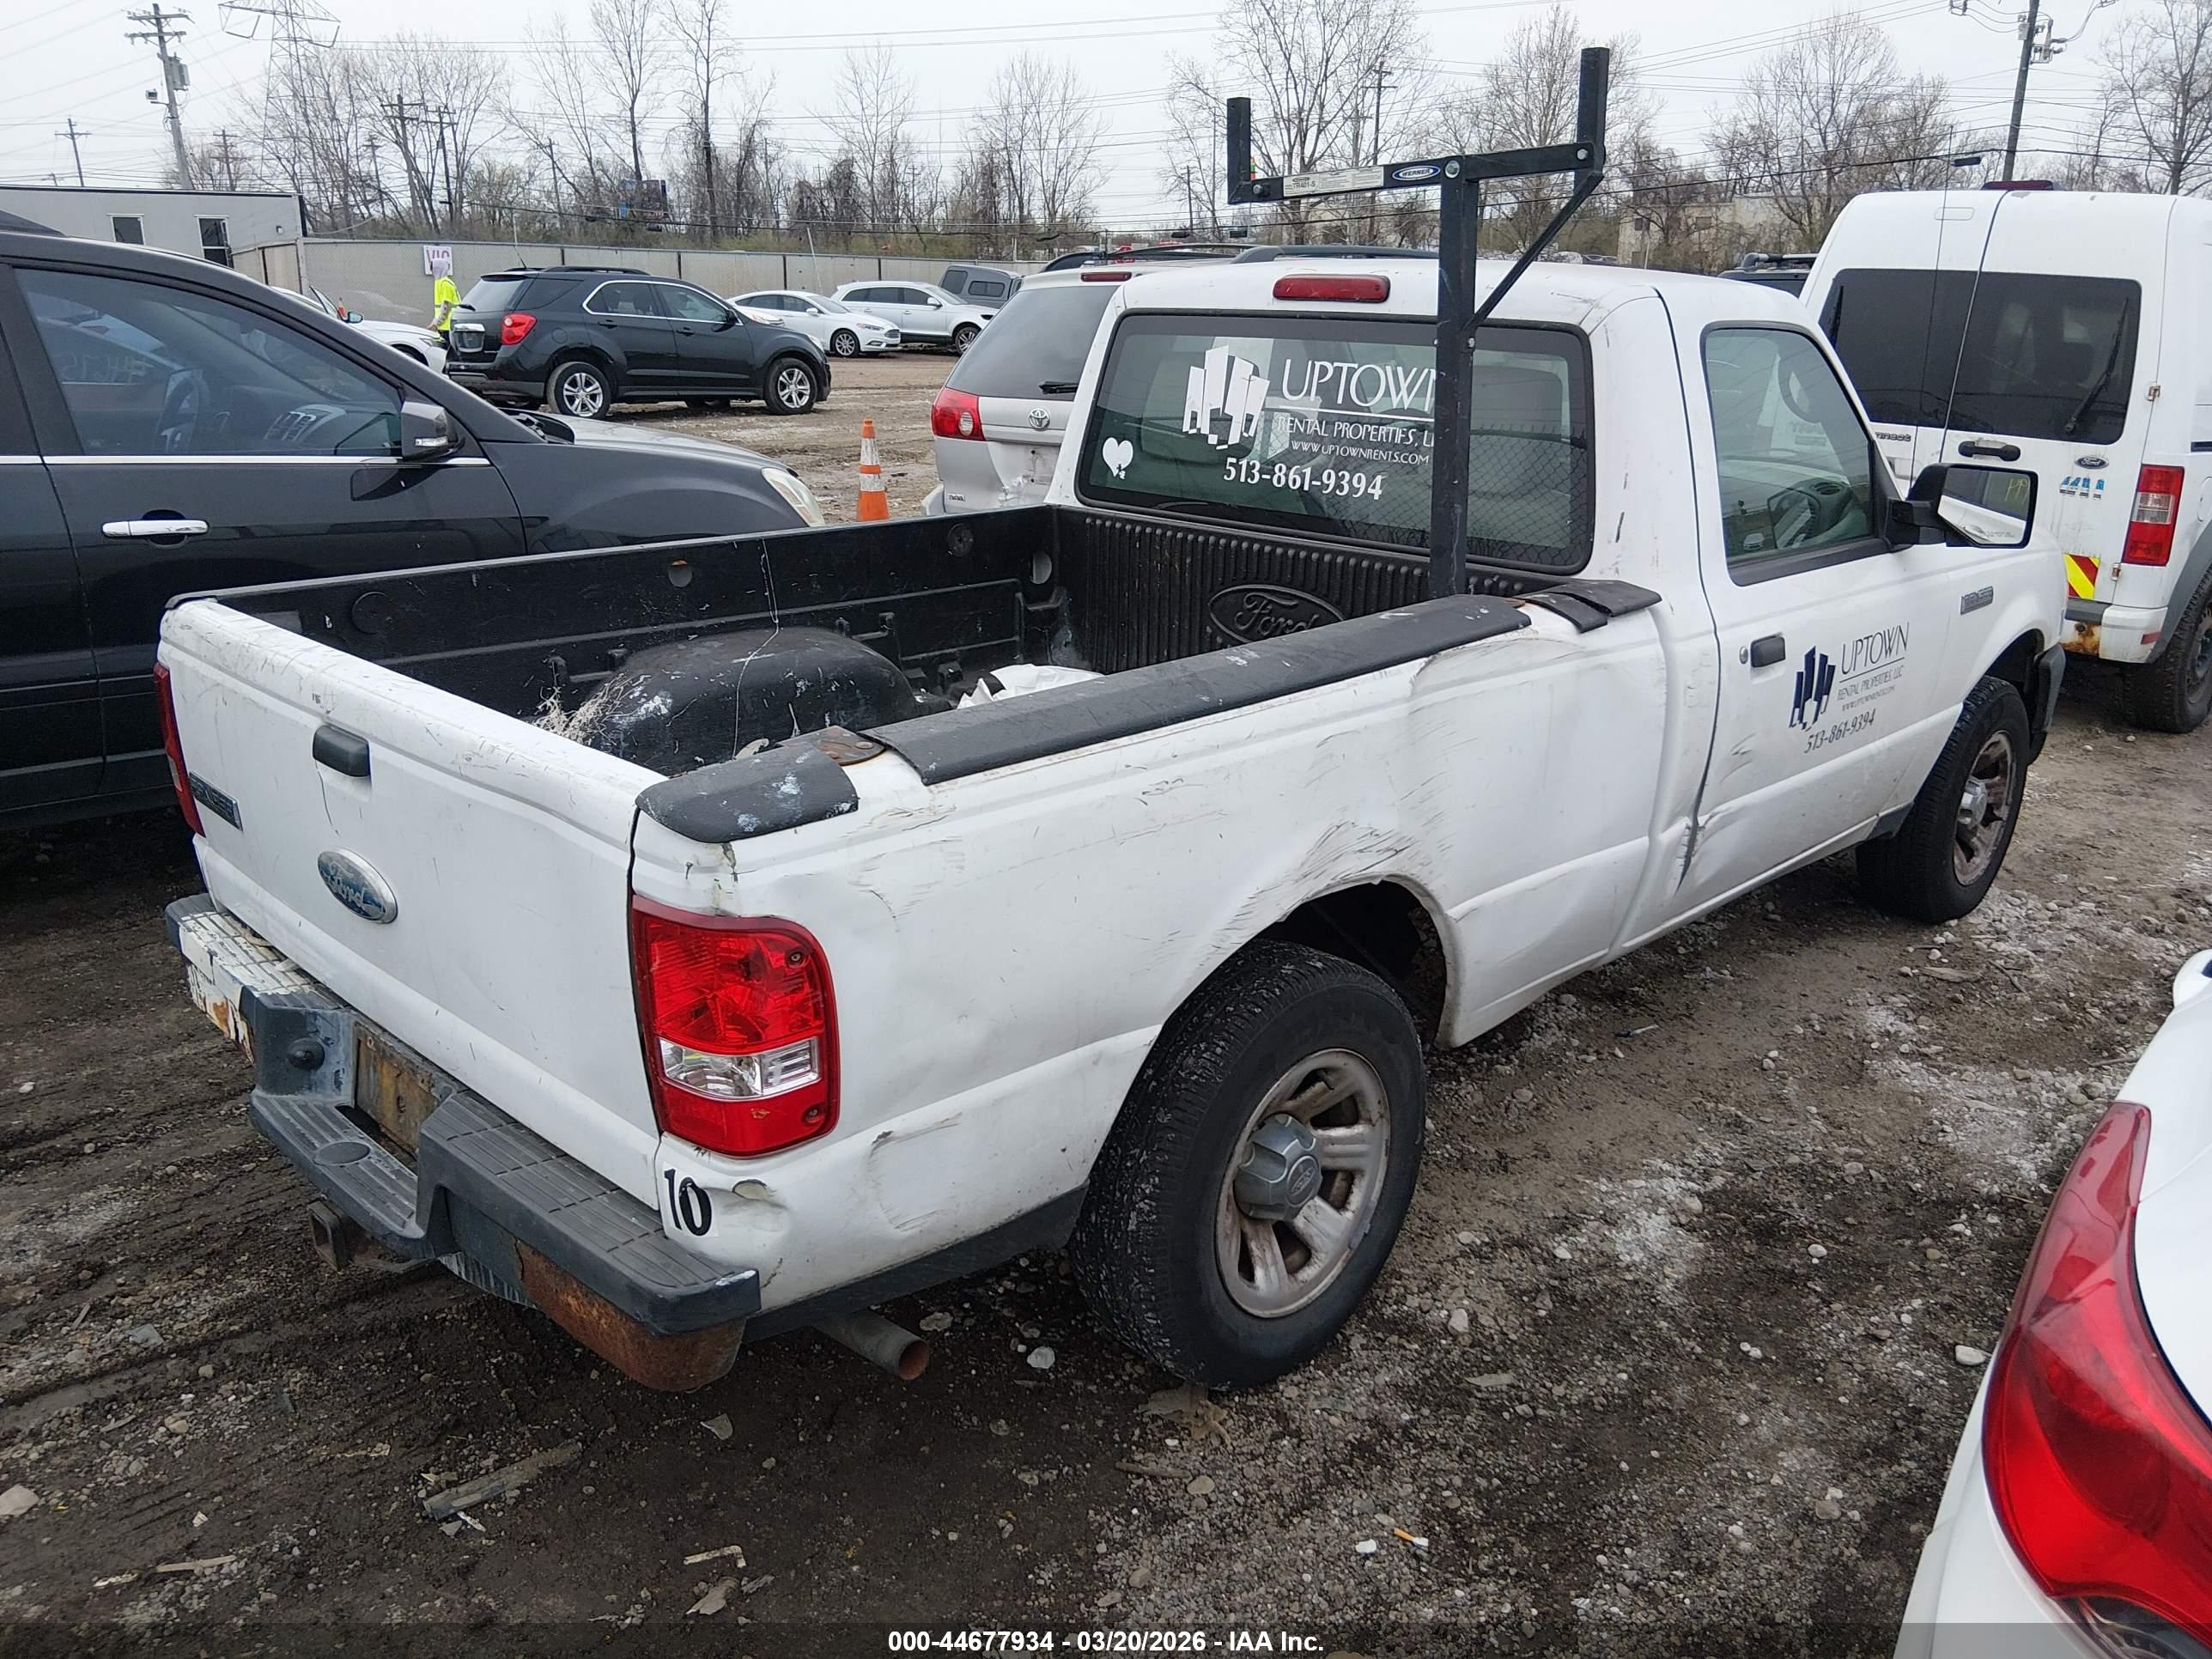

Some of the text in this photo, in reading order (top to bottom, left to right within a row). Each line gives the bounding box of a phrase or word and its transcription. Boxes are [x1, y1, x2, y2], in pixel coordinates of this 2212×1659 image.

[1401, 169, 1432, 178] WERNER
[1278, 416, 1328, 437] RENTAL
[1291, 440, 1430, 465] WWWUPTOWNRENTS.COM
[1223, 457, 1384, 501] 513-861-9394
[1234, 592, 1320, 635] Ford
[1841, 622, 1909, 675] UPTOWN
[1804, 708, 1876, 754] 513-861-9394
[664, 1168, 713, 1237] 10
